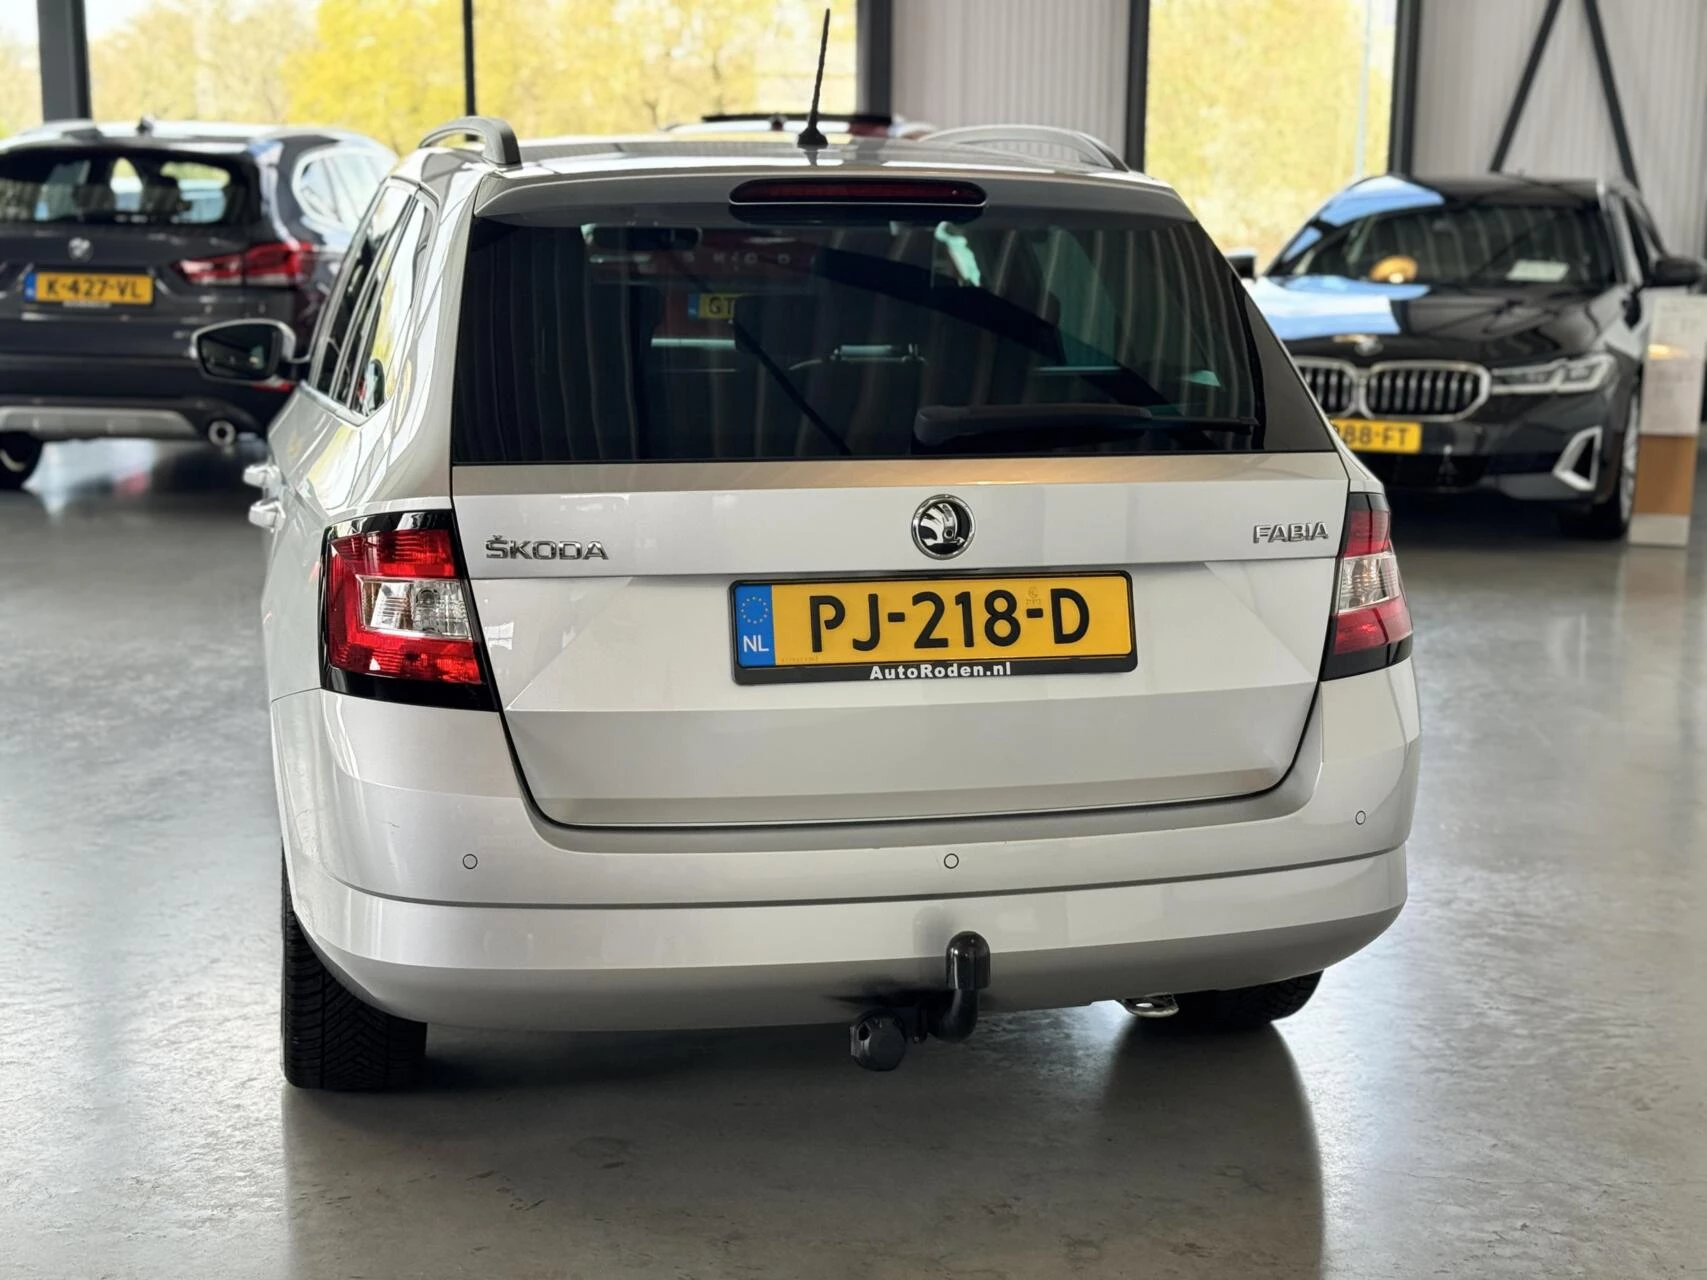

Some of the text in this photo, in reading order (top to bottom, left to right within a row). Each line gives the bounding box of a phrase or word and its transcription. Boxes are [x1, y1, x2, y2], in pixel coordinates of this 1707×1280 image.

[46, 277, 142, 298] K-427-VL
[1252, 521, 1329, 544] FABIA
[485, 534, 609, 560] ŠKODA
[808, 588, 1090, 653] PJ-218-D
[743, 634, 770, 653] NL
[869, 661, 1011, 680] AutoRoden.nl
